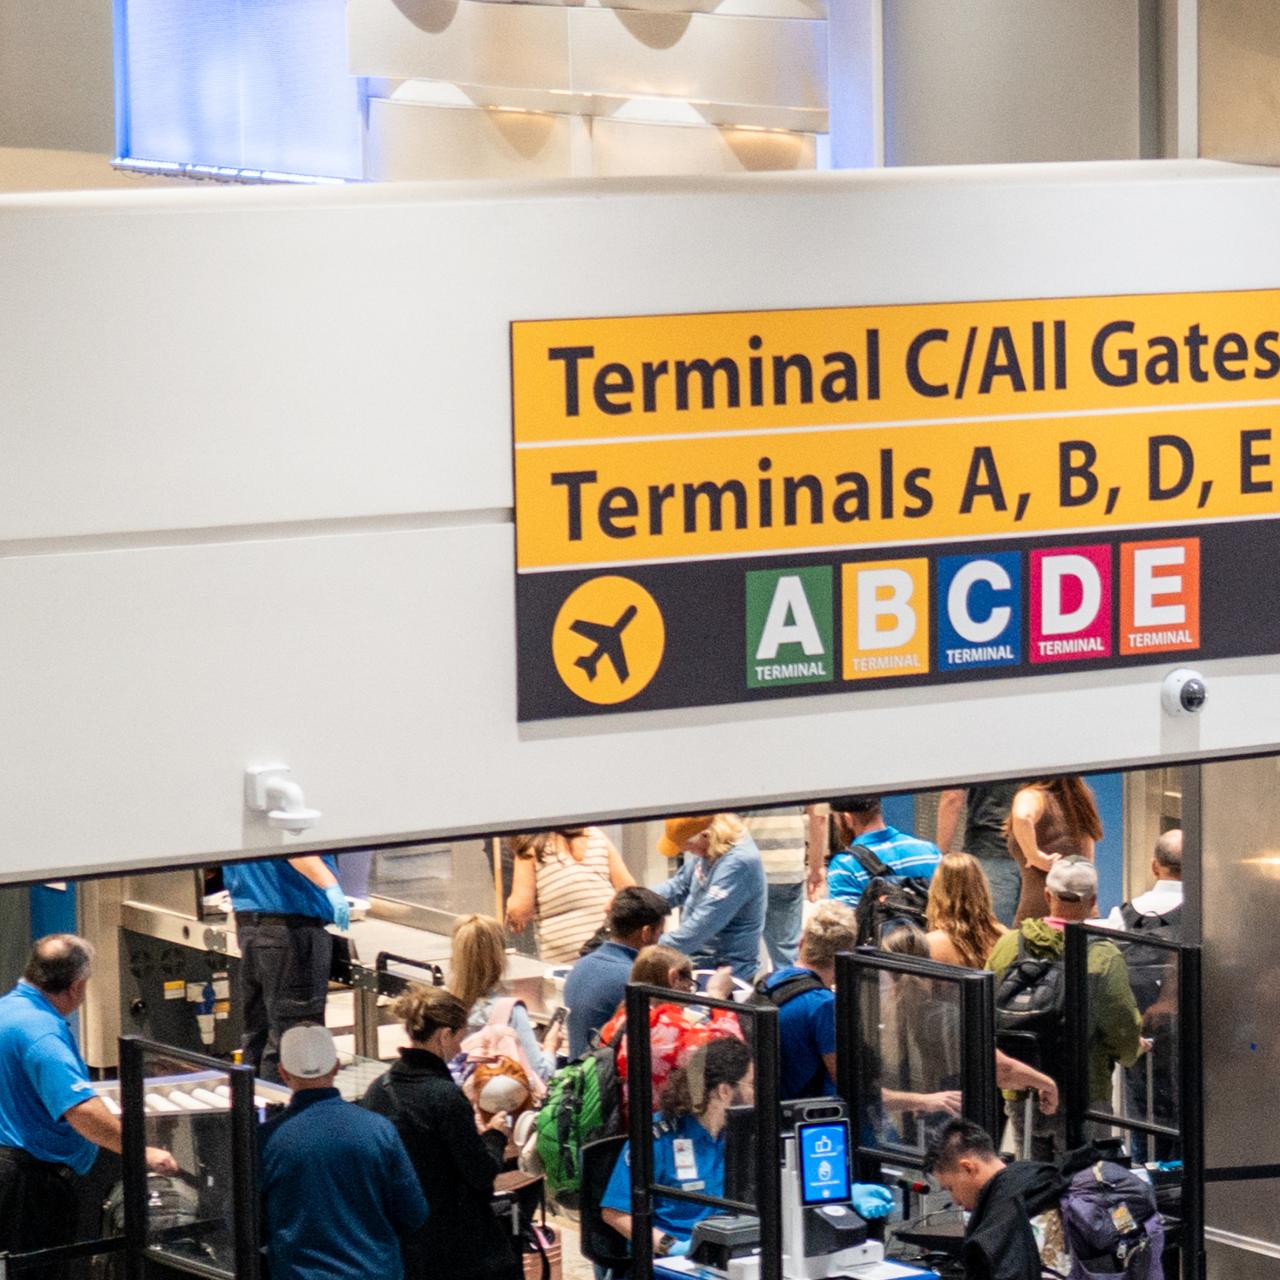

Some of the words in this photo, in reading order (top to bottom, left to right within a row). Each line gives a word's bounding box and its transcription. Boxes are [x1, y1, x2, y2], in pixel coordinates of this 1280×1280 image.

[549, 329, 880, 416] Terminal
[906, 321, 1066, 399] C/All
[1092, 321, 1280, 386] Gates
[551, 449, 933, 541] Terminals
[960, 447, 1030, 521] A,
[1060, 441, 1120, 514] B,
[1149, 435, 1212, 508] D,
[1241, 429, 1272, 494] E
[755, 575, 825, 660] A
[857, 568, 917, 650] B
[947, 559, 1011, 643] C
[1041, 554, 1101, 635] D
[1134, 546, 1186, 628] E
[755, 661, 826, 681] TERMINAL
[853, 653, 921, 672] TERMINAL
[946, 645, 1014, 664] TERMINAL
[1038, 637, 1104, 656] TERMINAL
[1128, 629, 1192, 648] TERMINAL
